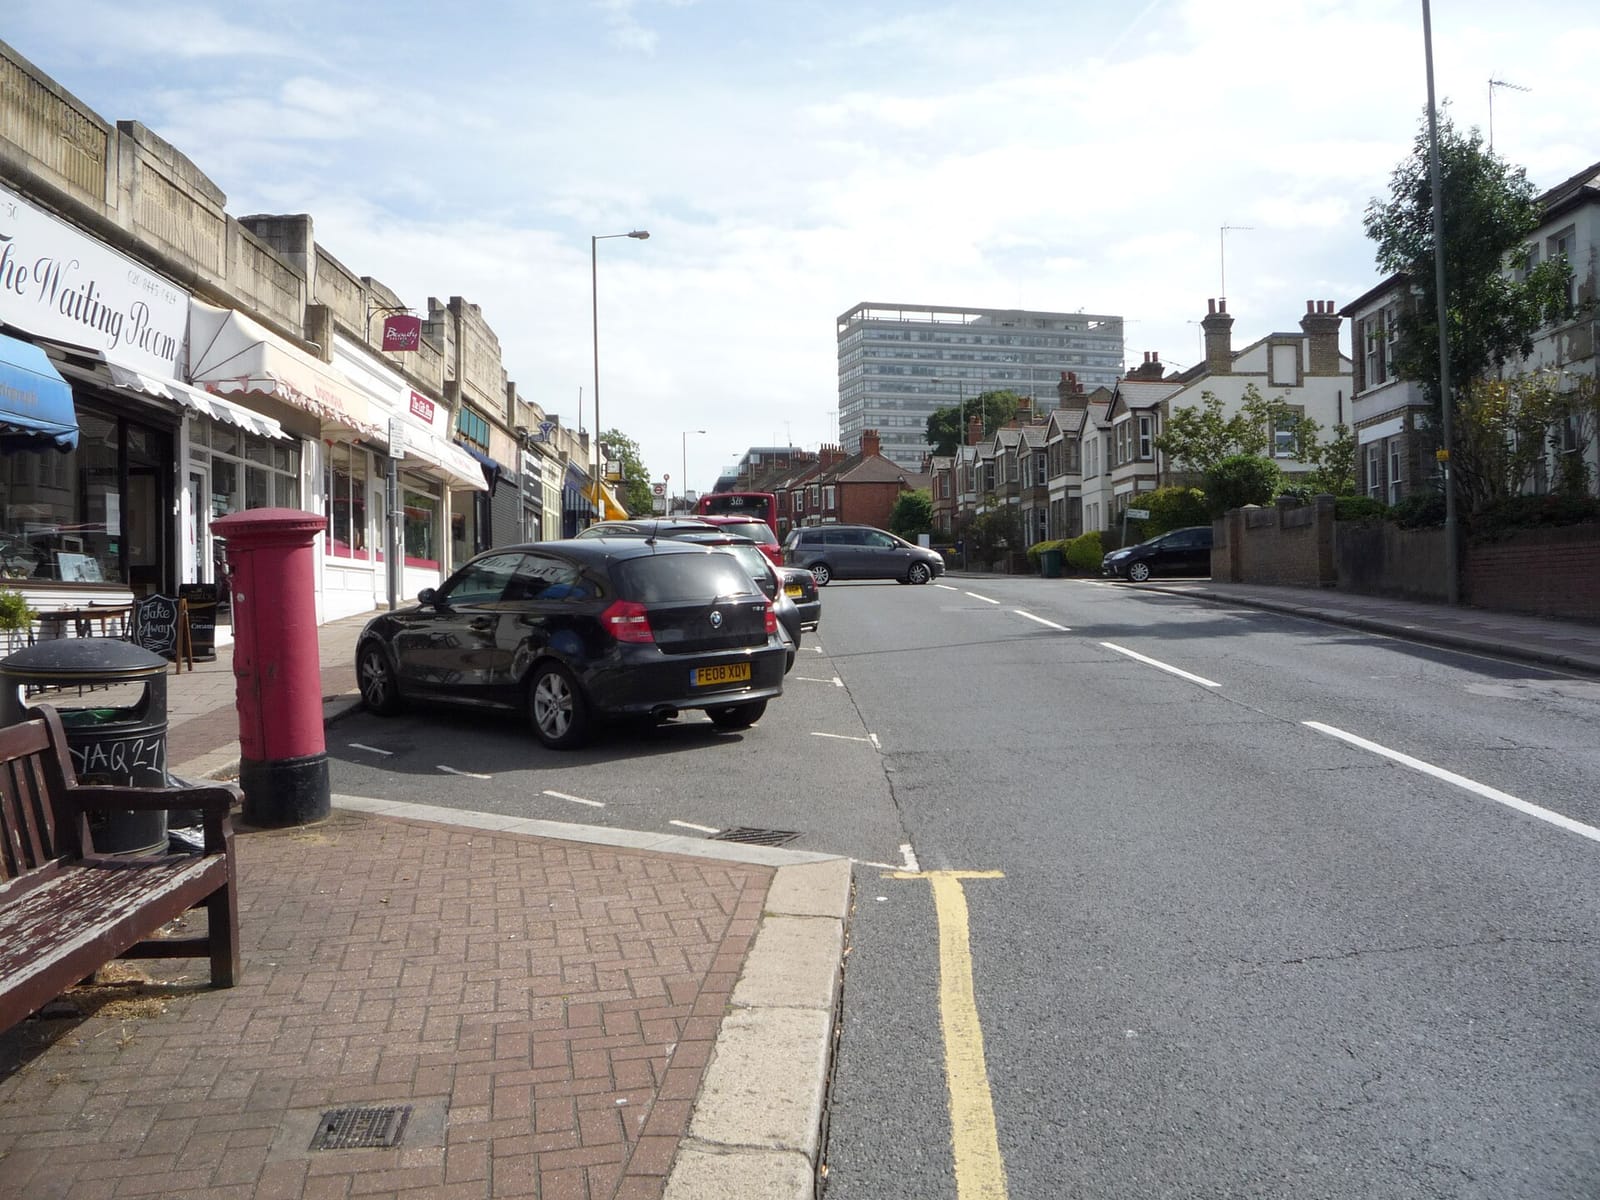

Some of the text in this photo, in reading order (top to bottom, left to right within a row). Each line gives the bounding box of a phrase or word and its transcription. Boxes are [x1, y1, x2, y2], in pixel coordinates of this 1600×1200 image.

[33, 257, 124, 350] Waiting
[125, 300, 176, 362] Room
[386, 326, 418, 345] Beauty
[730, 495, 744, 506] 326
[142, 601, 171, 620] Take
[139, 620, 171, 640] Away
[697, 667, 726, 682] FE08
